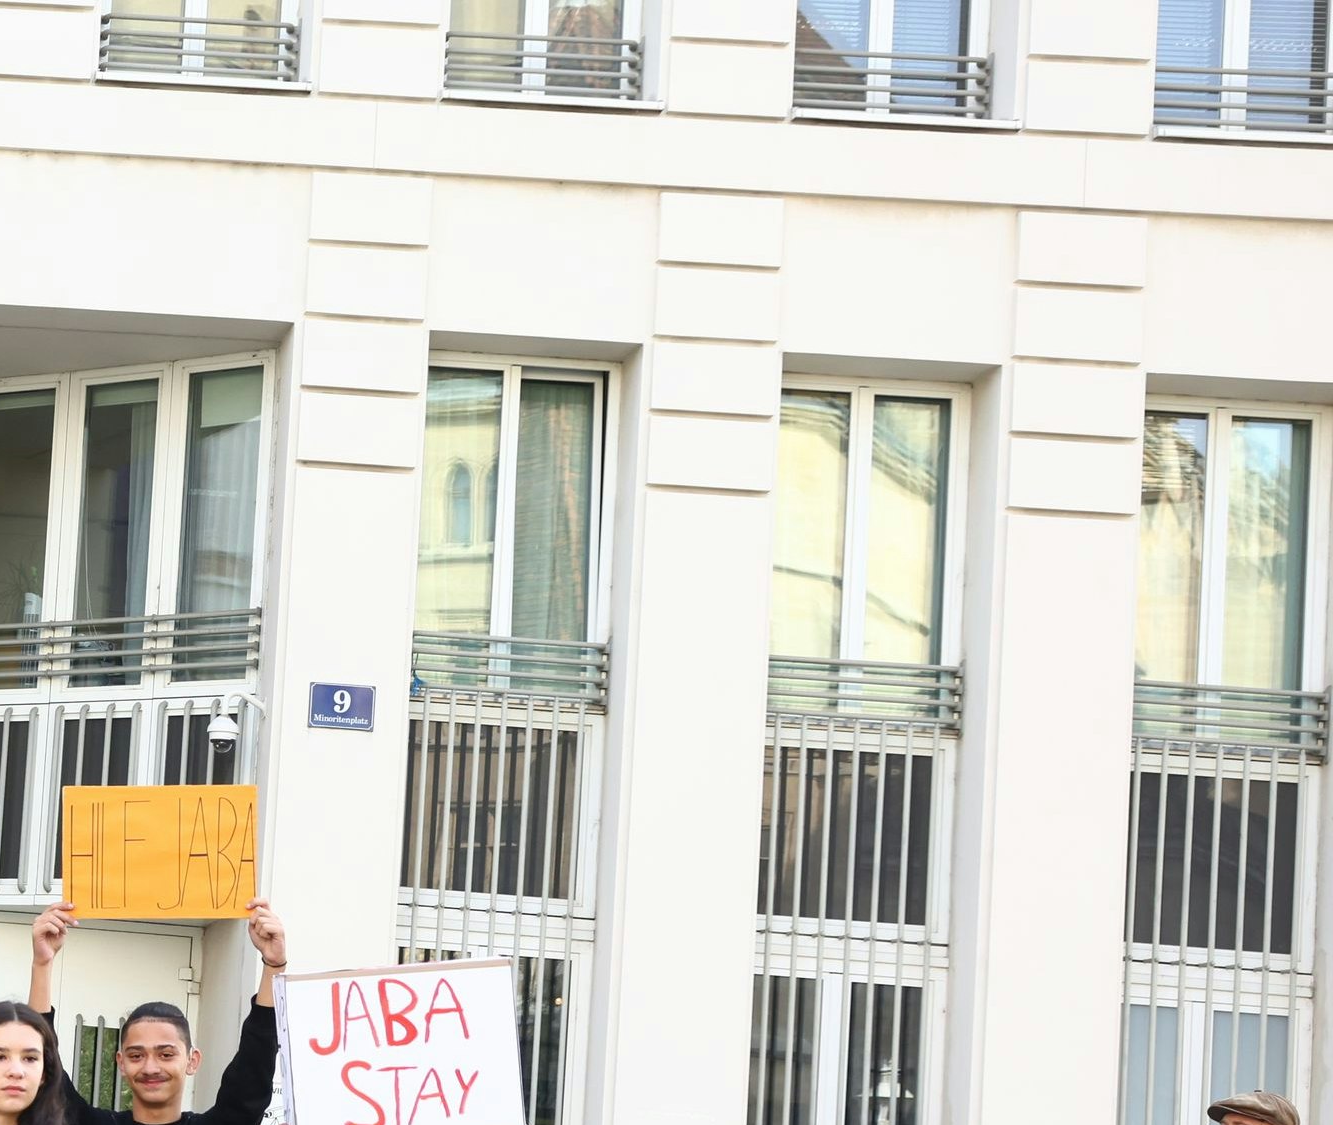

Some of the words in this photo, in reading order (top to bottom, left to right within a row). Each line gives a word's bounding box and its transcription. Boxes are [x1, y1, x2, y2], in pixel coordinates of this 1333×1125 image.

[314, 713, 369, 725] Minoritenplatz
[333, 690, 351, 713] 9
[70, 800, 151, 909] HILF
[156, 797, 256, 910] JABA
[308, 977, 470, 1056] JABA
